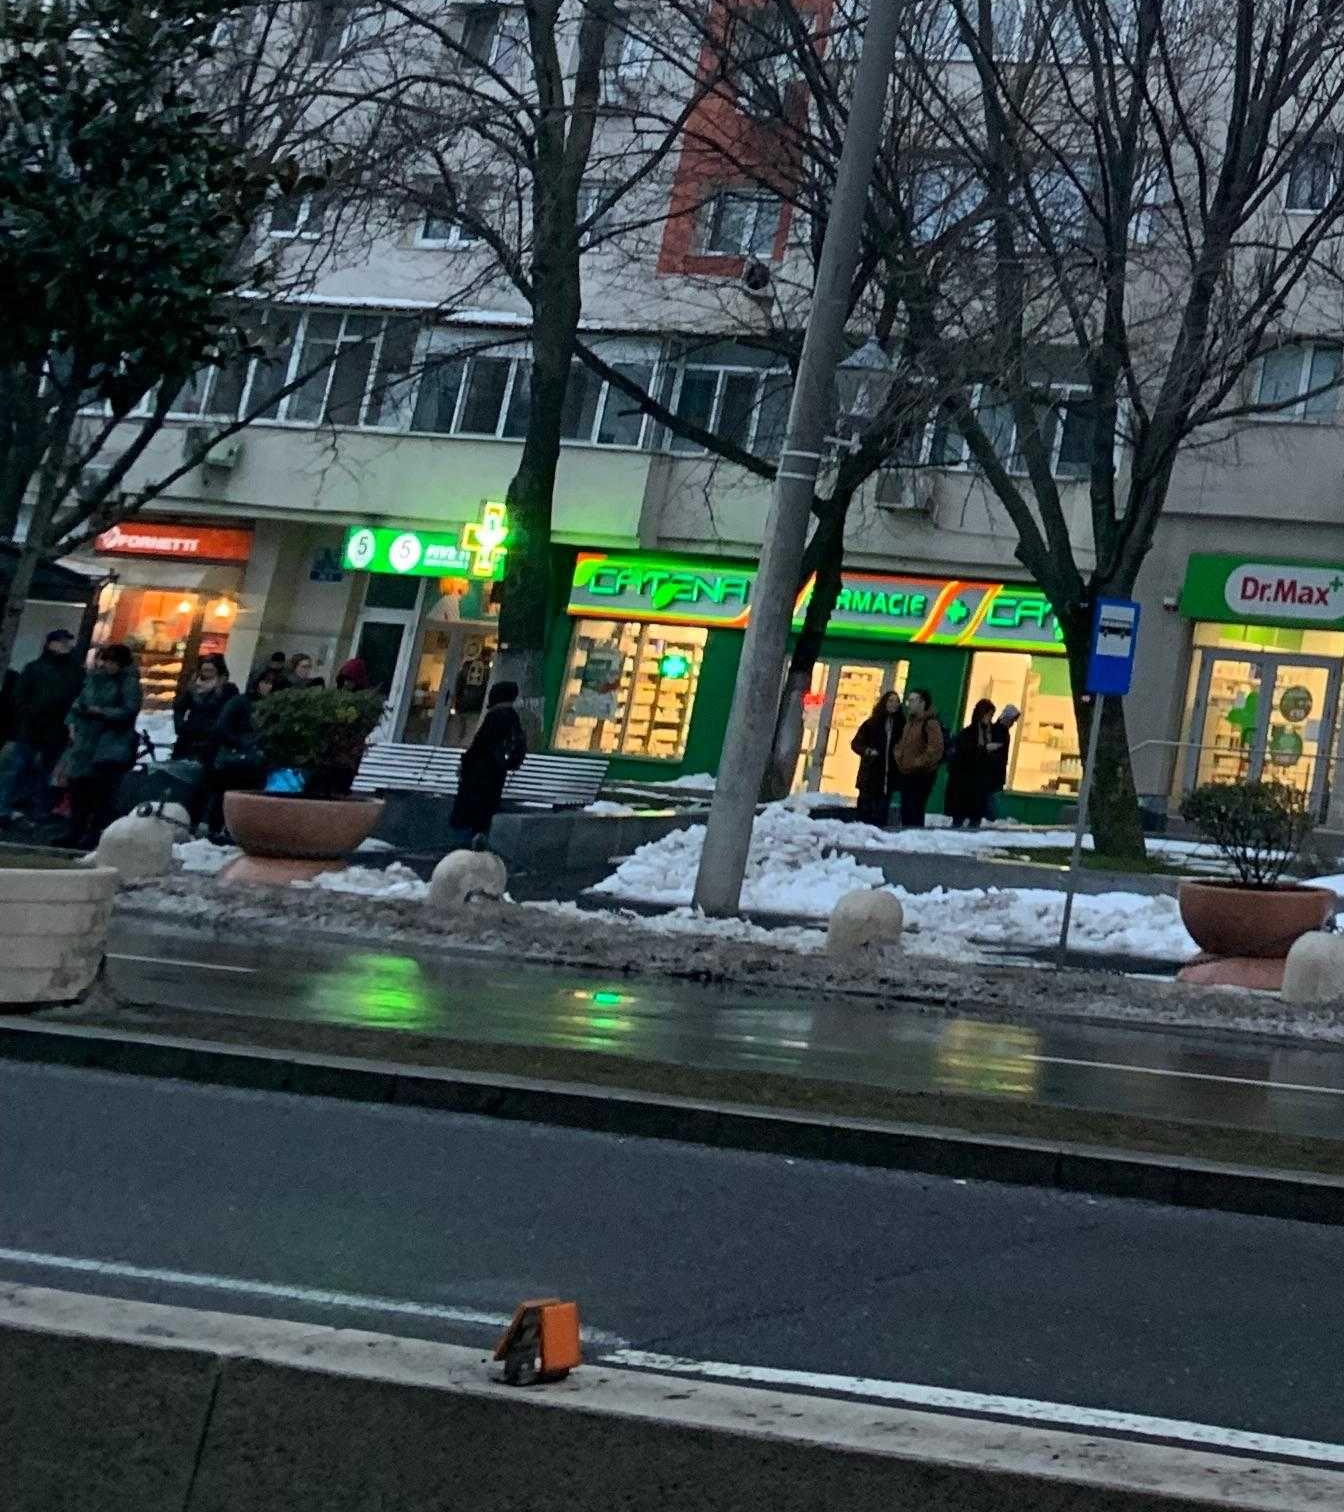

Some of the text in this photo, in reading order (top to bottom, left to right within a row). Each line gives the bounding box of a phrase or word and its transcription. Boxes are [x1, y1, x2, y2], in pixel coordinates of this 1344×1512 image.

[588, 566, 750, 605] CATENA
[835, 588, 926, 617] RMACIE
[1240, 576, 1330, 606] Dr.Max
